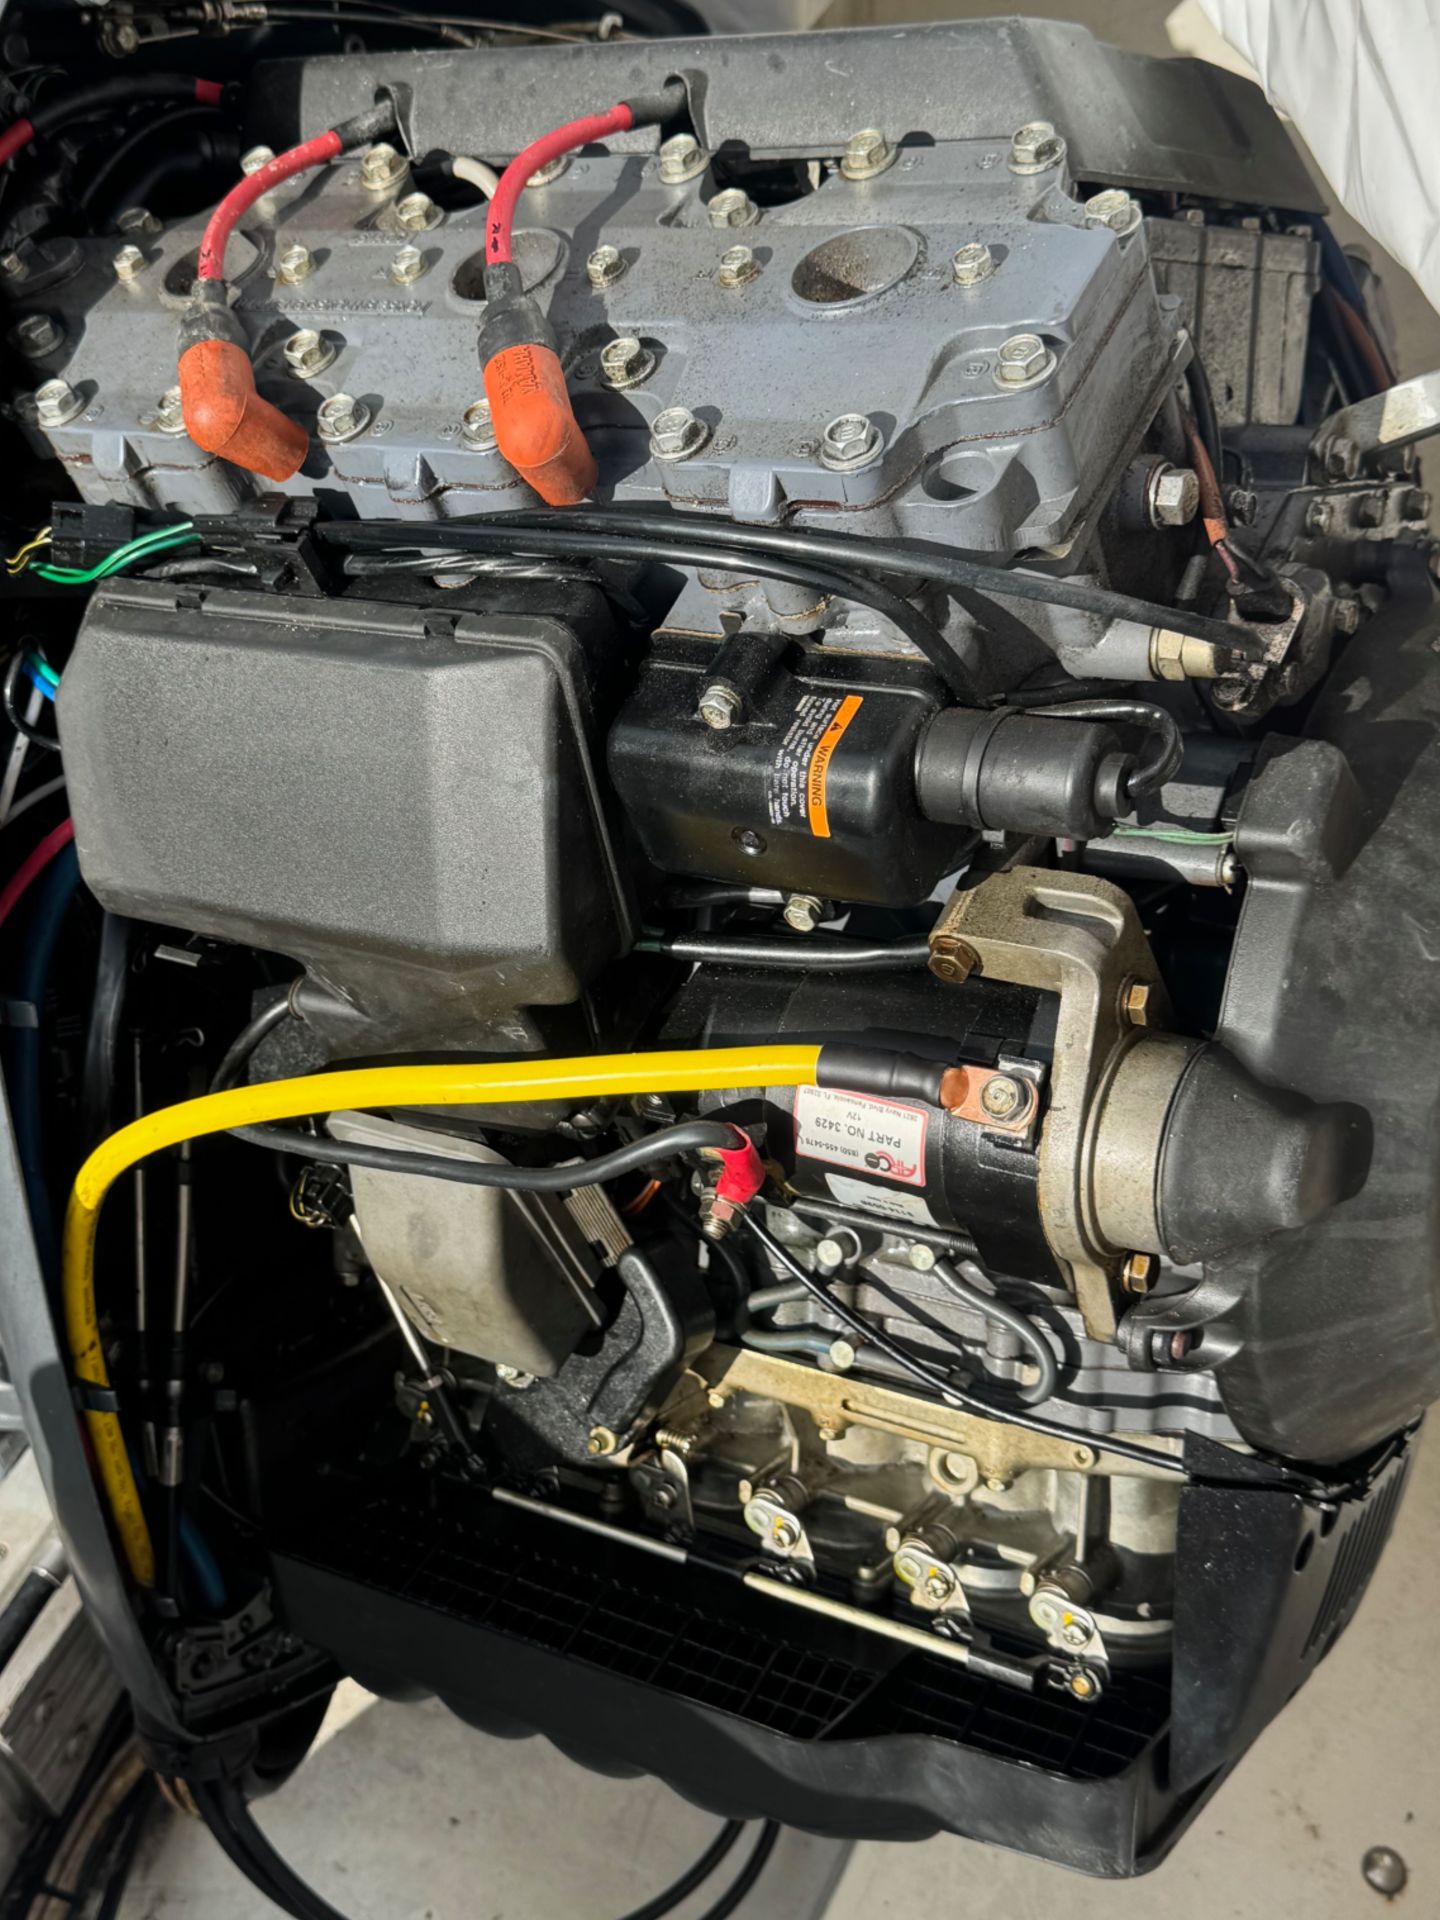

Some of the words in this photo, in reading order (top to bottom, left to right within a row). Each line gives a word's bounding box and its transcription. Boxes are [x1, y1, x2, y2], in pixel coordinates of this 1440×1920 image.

[802, 708, 818, 727] avoid
[806, 721, 818, 735] and
[795, 738, 808, 757] after
[801, 742, 814, 767] under
[775, 748, 785, 769] with
[782, 756, 790, 769] do
[781, 772, 790, 788] not
[790, 760, 800, 807] operation.
[799, 771, 807, 789] this
[811, 745, 831, 807] WARNING
[782, 792, 790, 818] touch
[799, 792, 807, 818] cover
[845, 1111, 861, 1121] 12V
[885, 1105, 901, 1116] Navy
[814, 1116, 841, 1132] 3429
[844, 1123, 865, 1138] NO.
[867, 1130, 901, 1148] PART
[864, 1150, 917, 1178] ARCO
